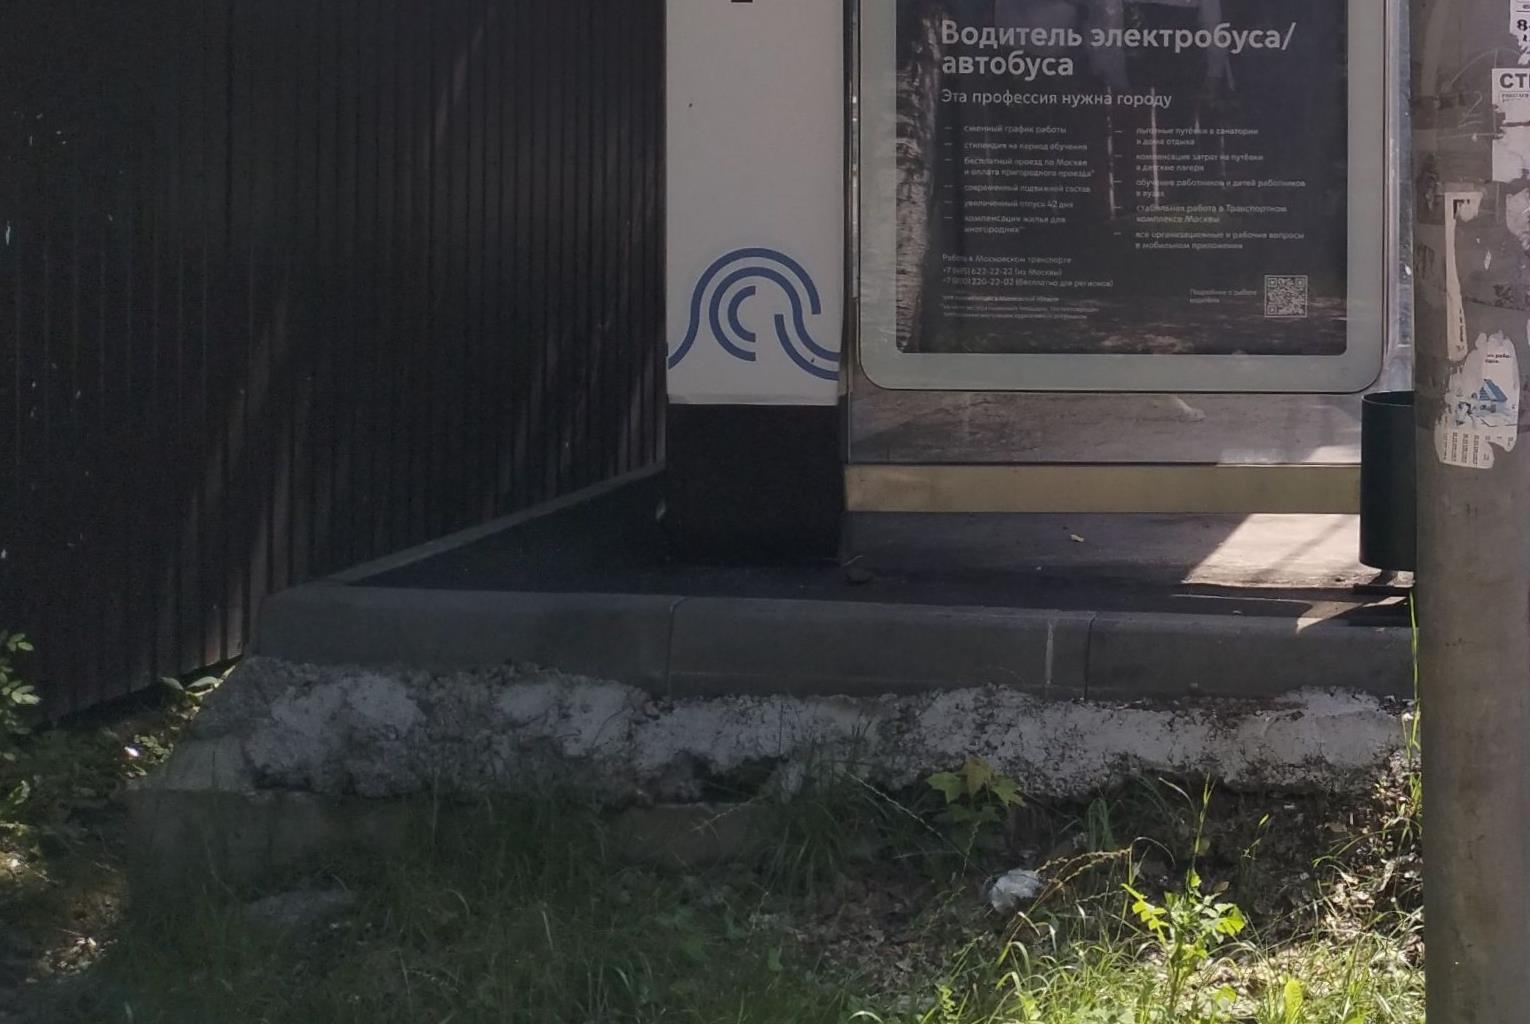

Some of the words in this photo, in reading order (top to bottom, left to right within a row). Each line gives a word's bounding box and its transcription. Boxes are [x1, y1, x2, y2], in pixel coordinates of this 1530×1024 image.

[941, 21, 1082, 49] Водитель
[1091, 22, 1296, 53] электробуса/
[942, 50, 1074, 80] автобуса
[941, 89, 967, 103] Эта
[972, 90, 1057, 106] профессия
[1062, 95, 1112, 107] нужна
[1117, 95, 1172, 108] городу
[1035, 126, 1066, 135] работы
